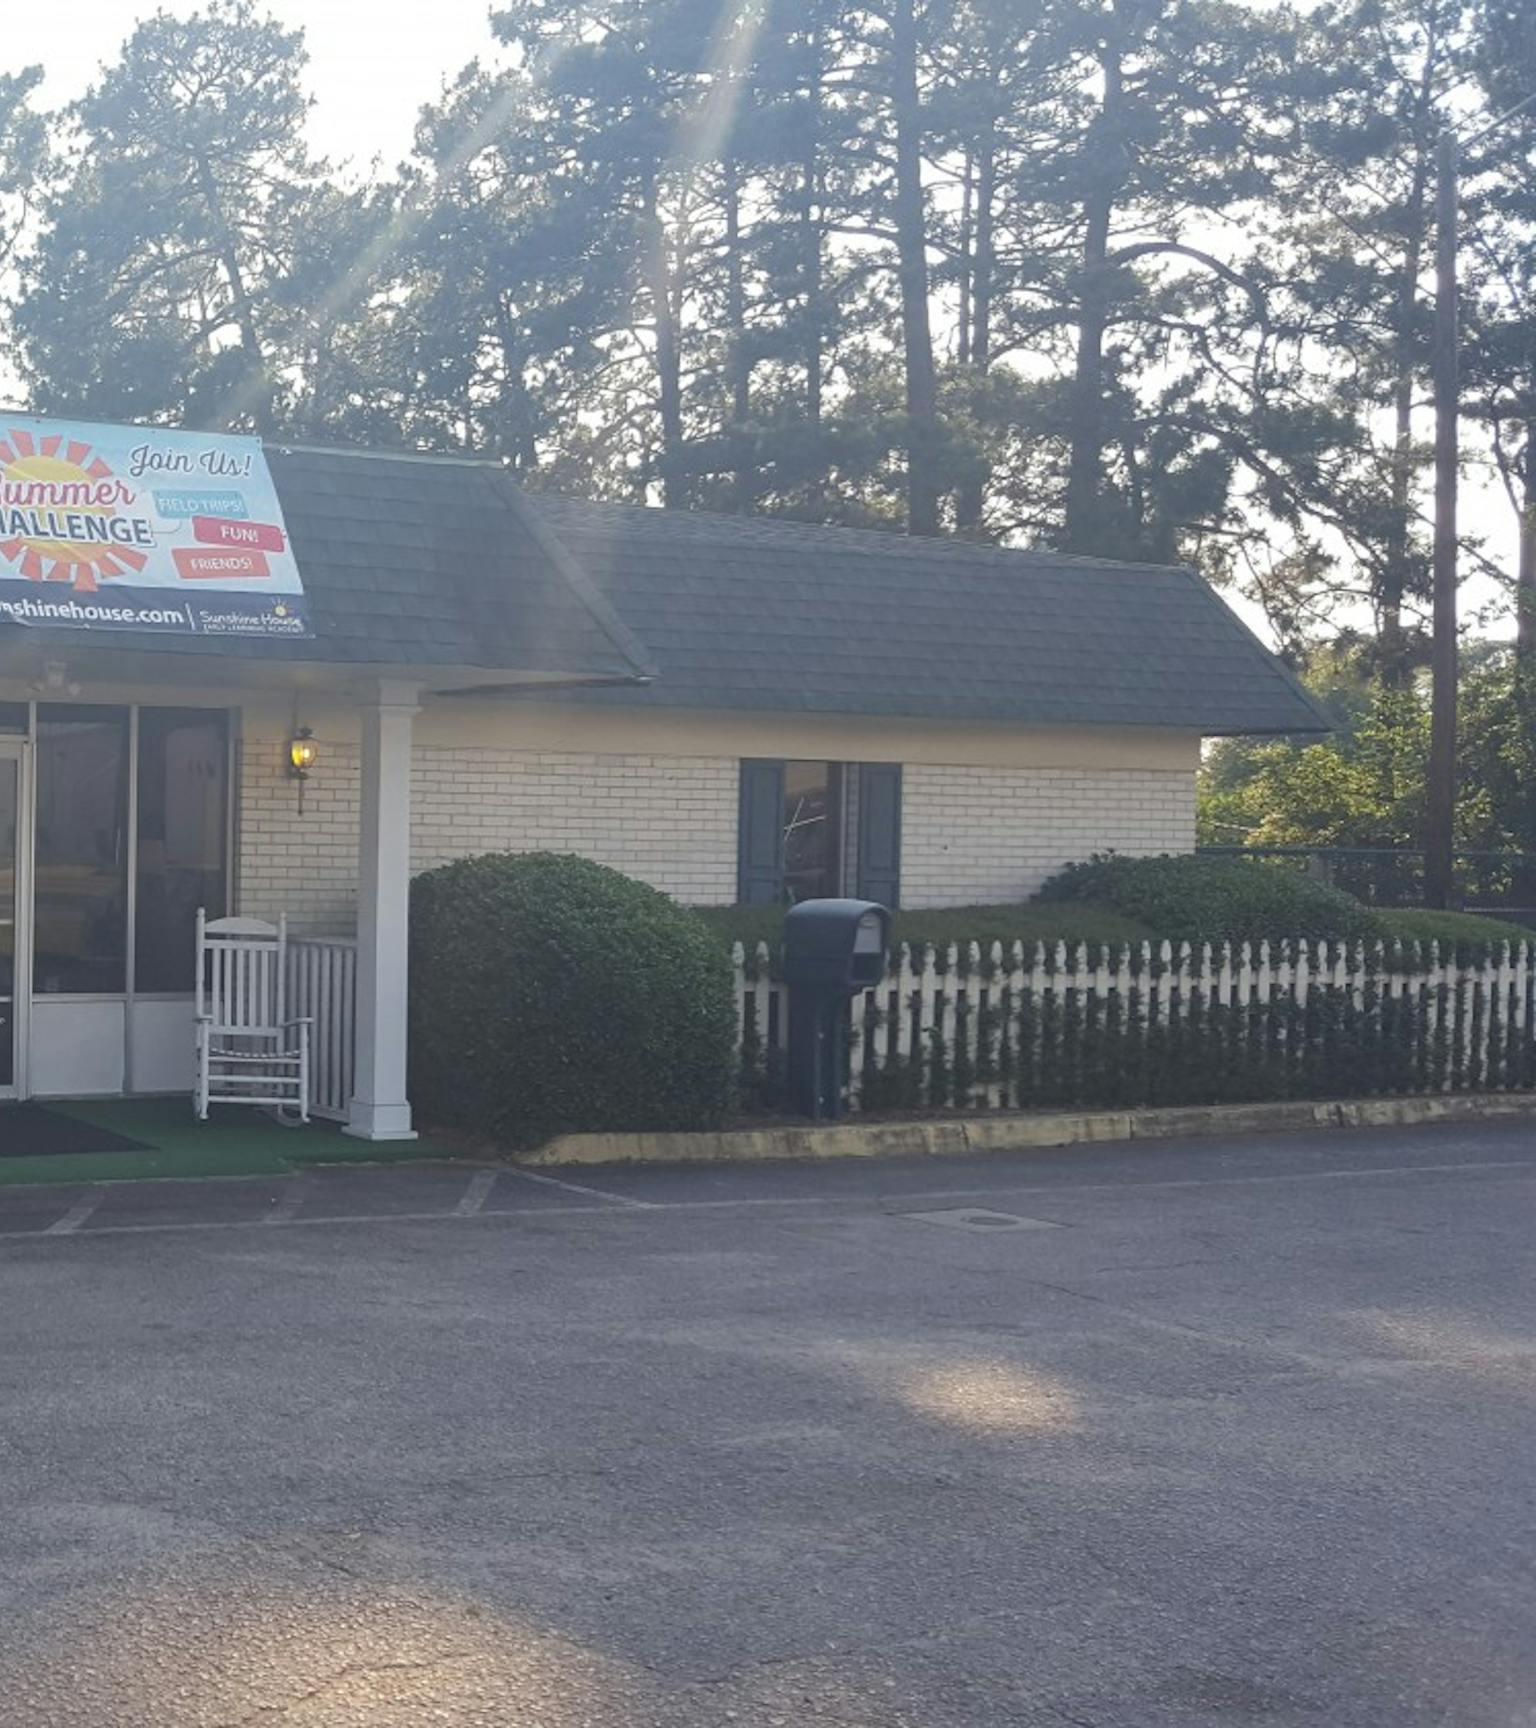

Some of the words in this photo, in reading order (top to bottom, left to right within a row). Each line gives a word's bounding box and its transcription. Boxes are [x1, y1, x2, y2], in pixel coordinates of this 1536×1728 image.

[130, 445, 194, 477] Join
[200, 450, 252, 476] Us!
[159, 498, 198, 513] FIELD
[220, 526, 259, 543] FUN!
[191, 557, 252, 570] FRIENDS!
